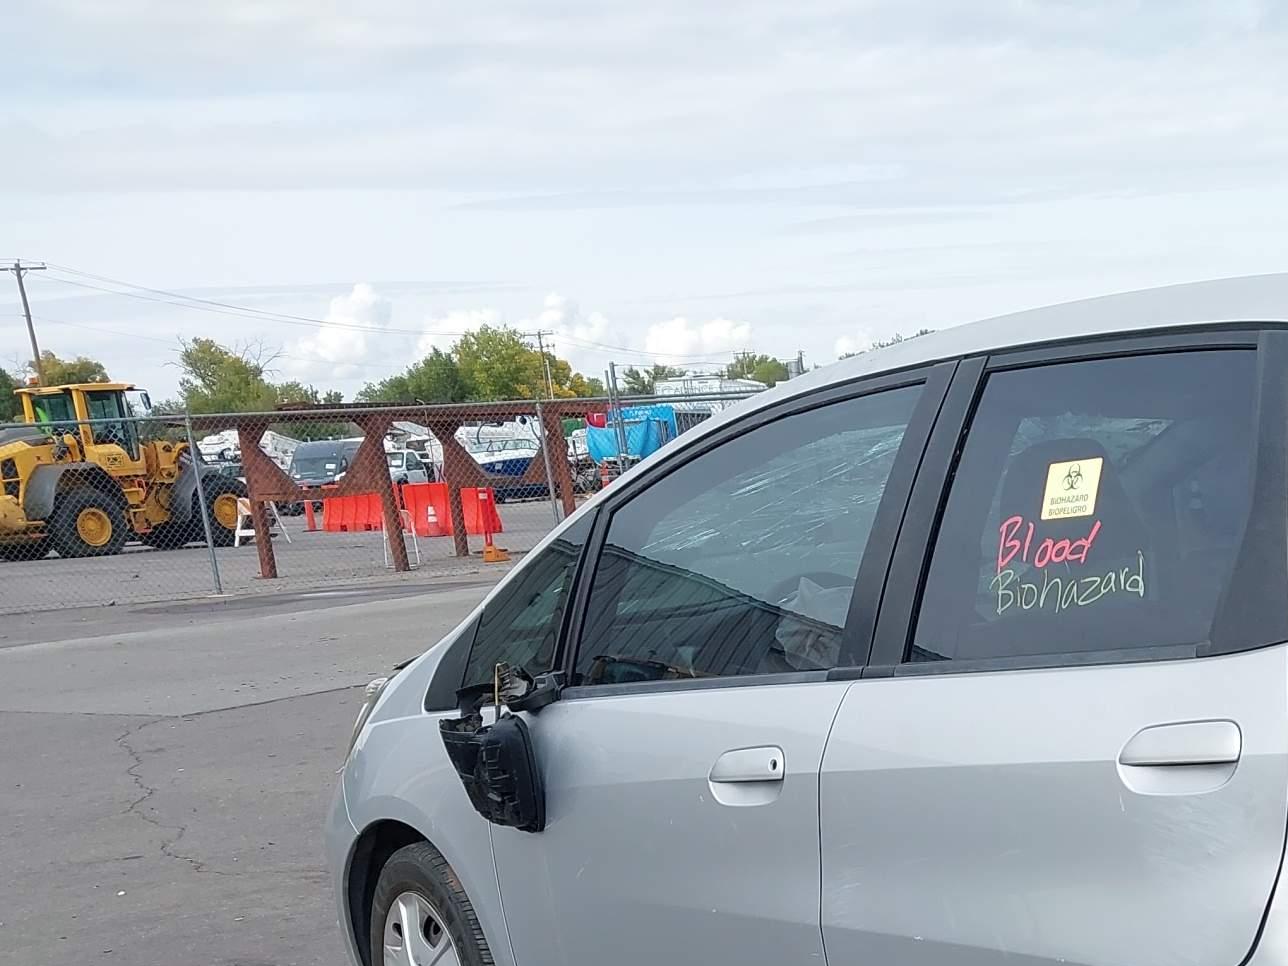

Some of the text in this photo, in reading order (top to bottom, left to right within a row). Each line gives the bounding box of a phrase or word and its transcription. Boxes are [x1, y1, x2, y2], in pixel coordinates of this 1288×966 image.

[1048, 505, 1087, 517] BIOPELIGRO
[1050, 494, 1089, 506] BIOHAZARD
[996, 515, 1102, 574] Blood
[989, 550, 1145, 615] Biohazard
